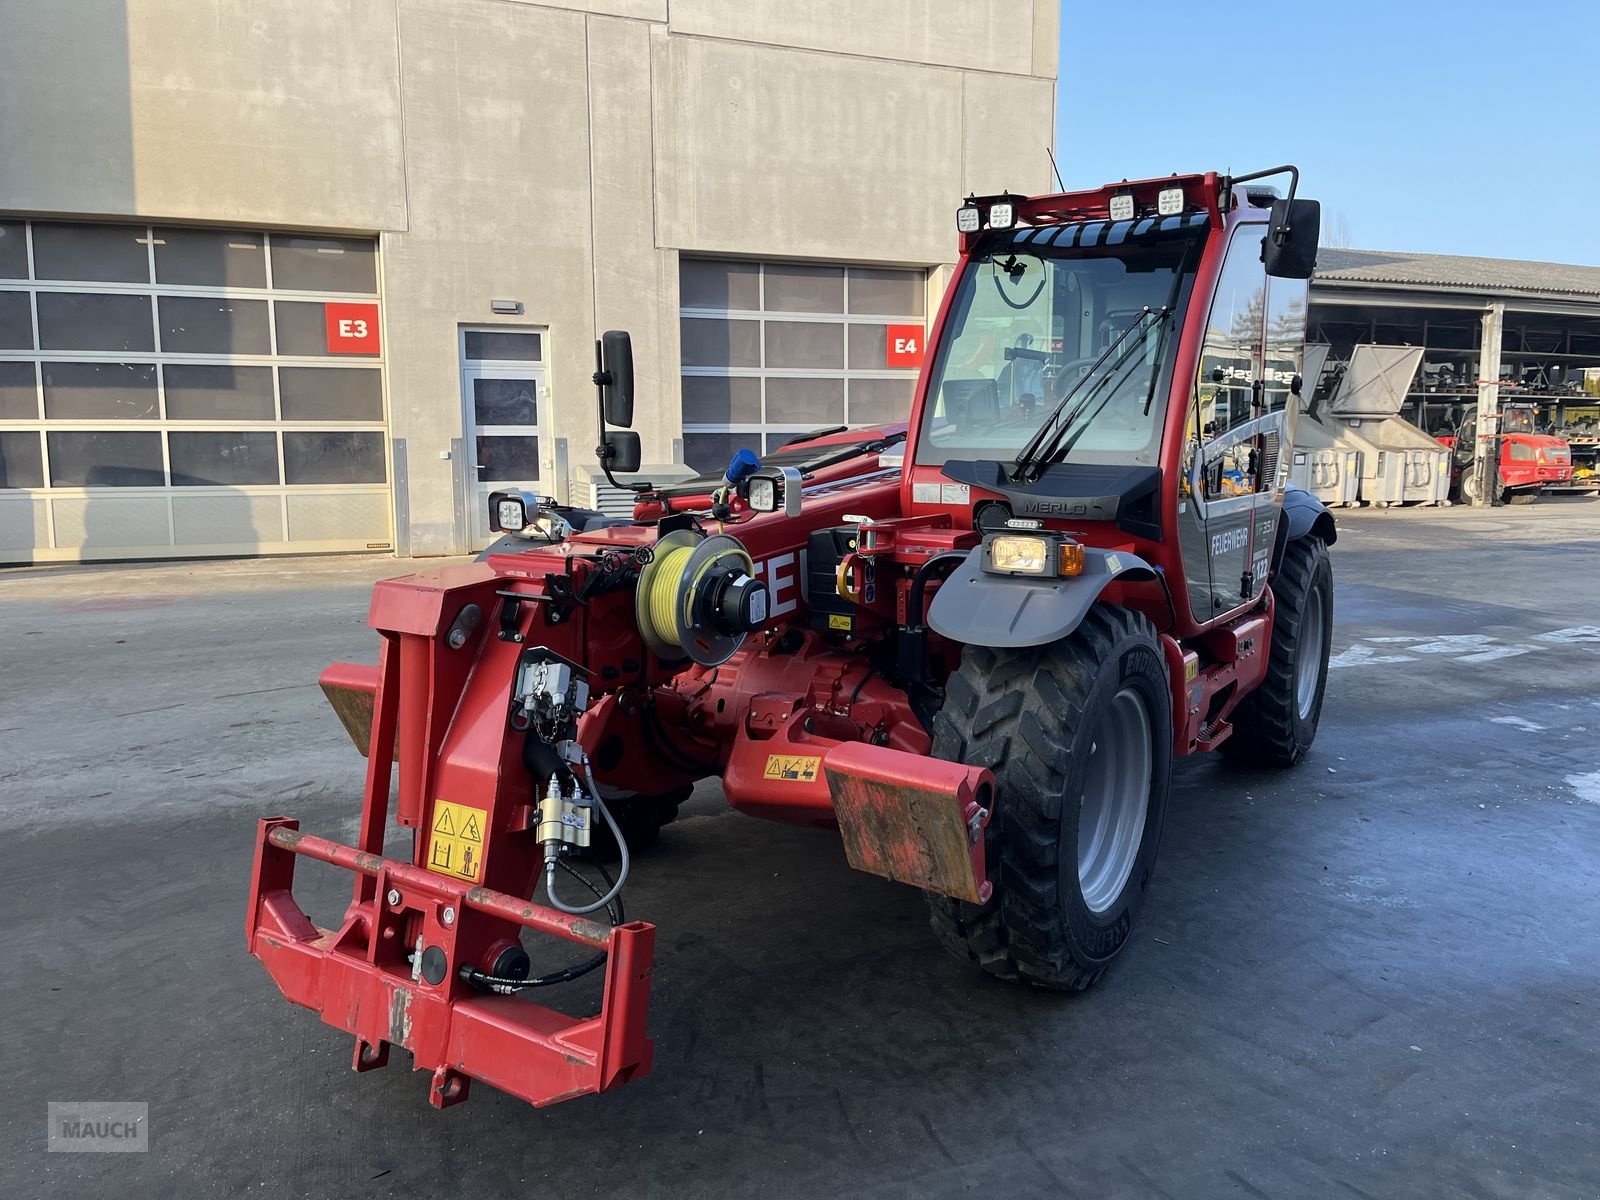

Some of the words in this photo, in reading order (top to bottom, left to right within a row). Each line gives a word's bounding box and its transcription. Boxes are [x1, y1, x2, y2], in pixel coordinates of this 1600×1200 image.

[339, 319, 368, 338] E3
[895, 338, 917, 354] E4
[1025, 501, 1087, 515] MERLO
[1211, 527, 1248, 557] FEUERWEHR
